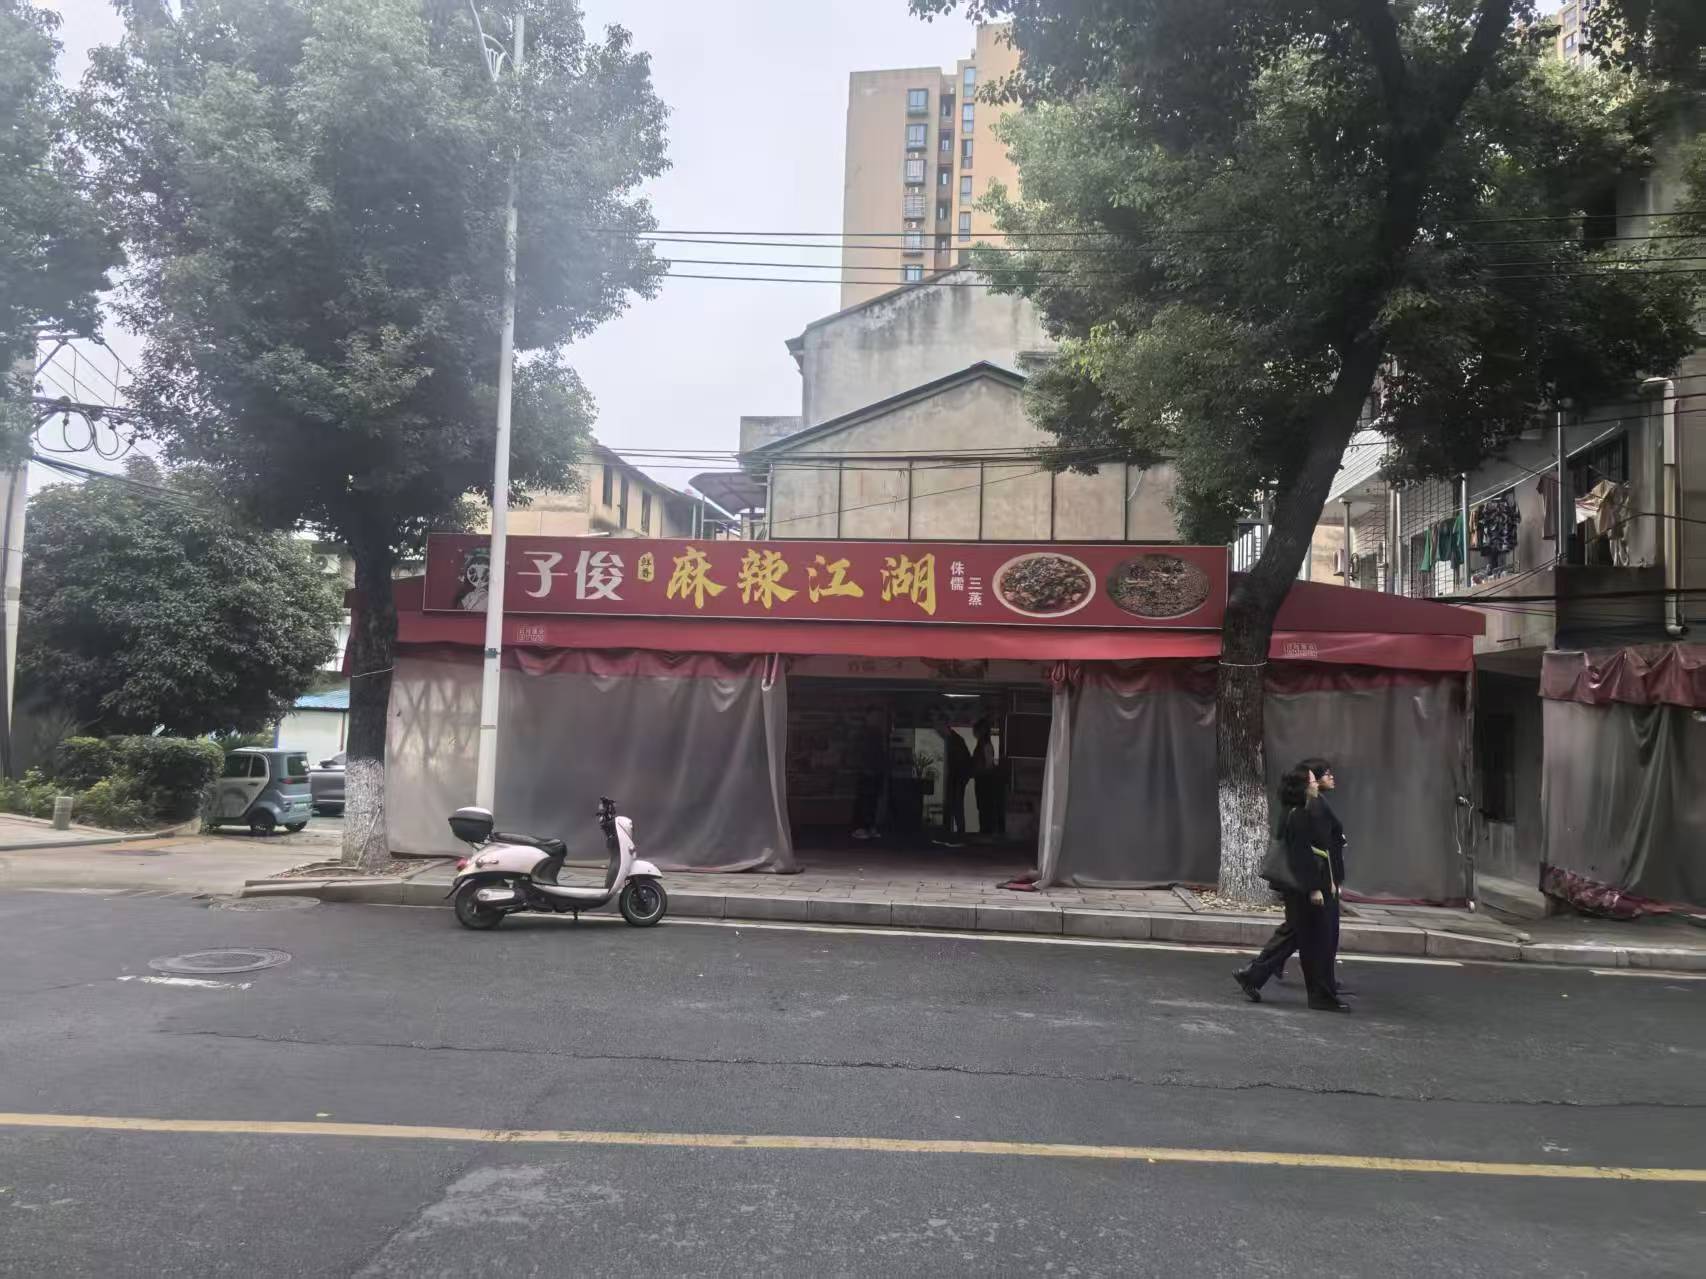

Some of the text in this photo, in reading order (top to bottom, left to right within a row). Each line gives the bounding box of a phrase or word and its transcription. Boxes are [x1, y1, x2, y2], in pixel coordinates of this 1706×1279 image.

[517, 545, 937, 616] 子俊 麻辣江湖
[950, 560, 965, 592] 侏儒
[967, 576, 983, 606] 三蒸
